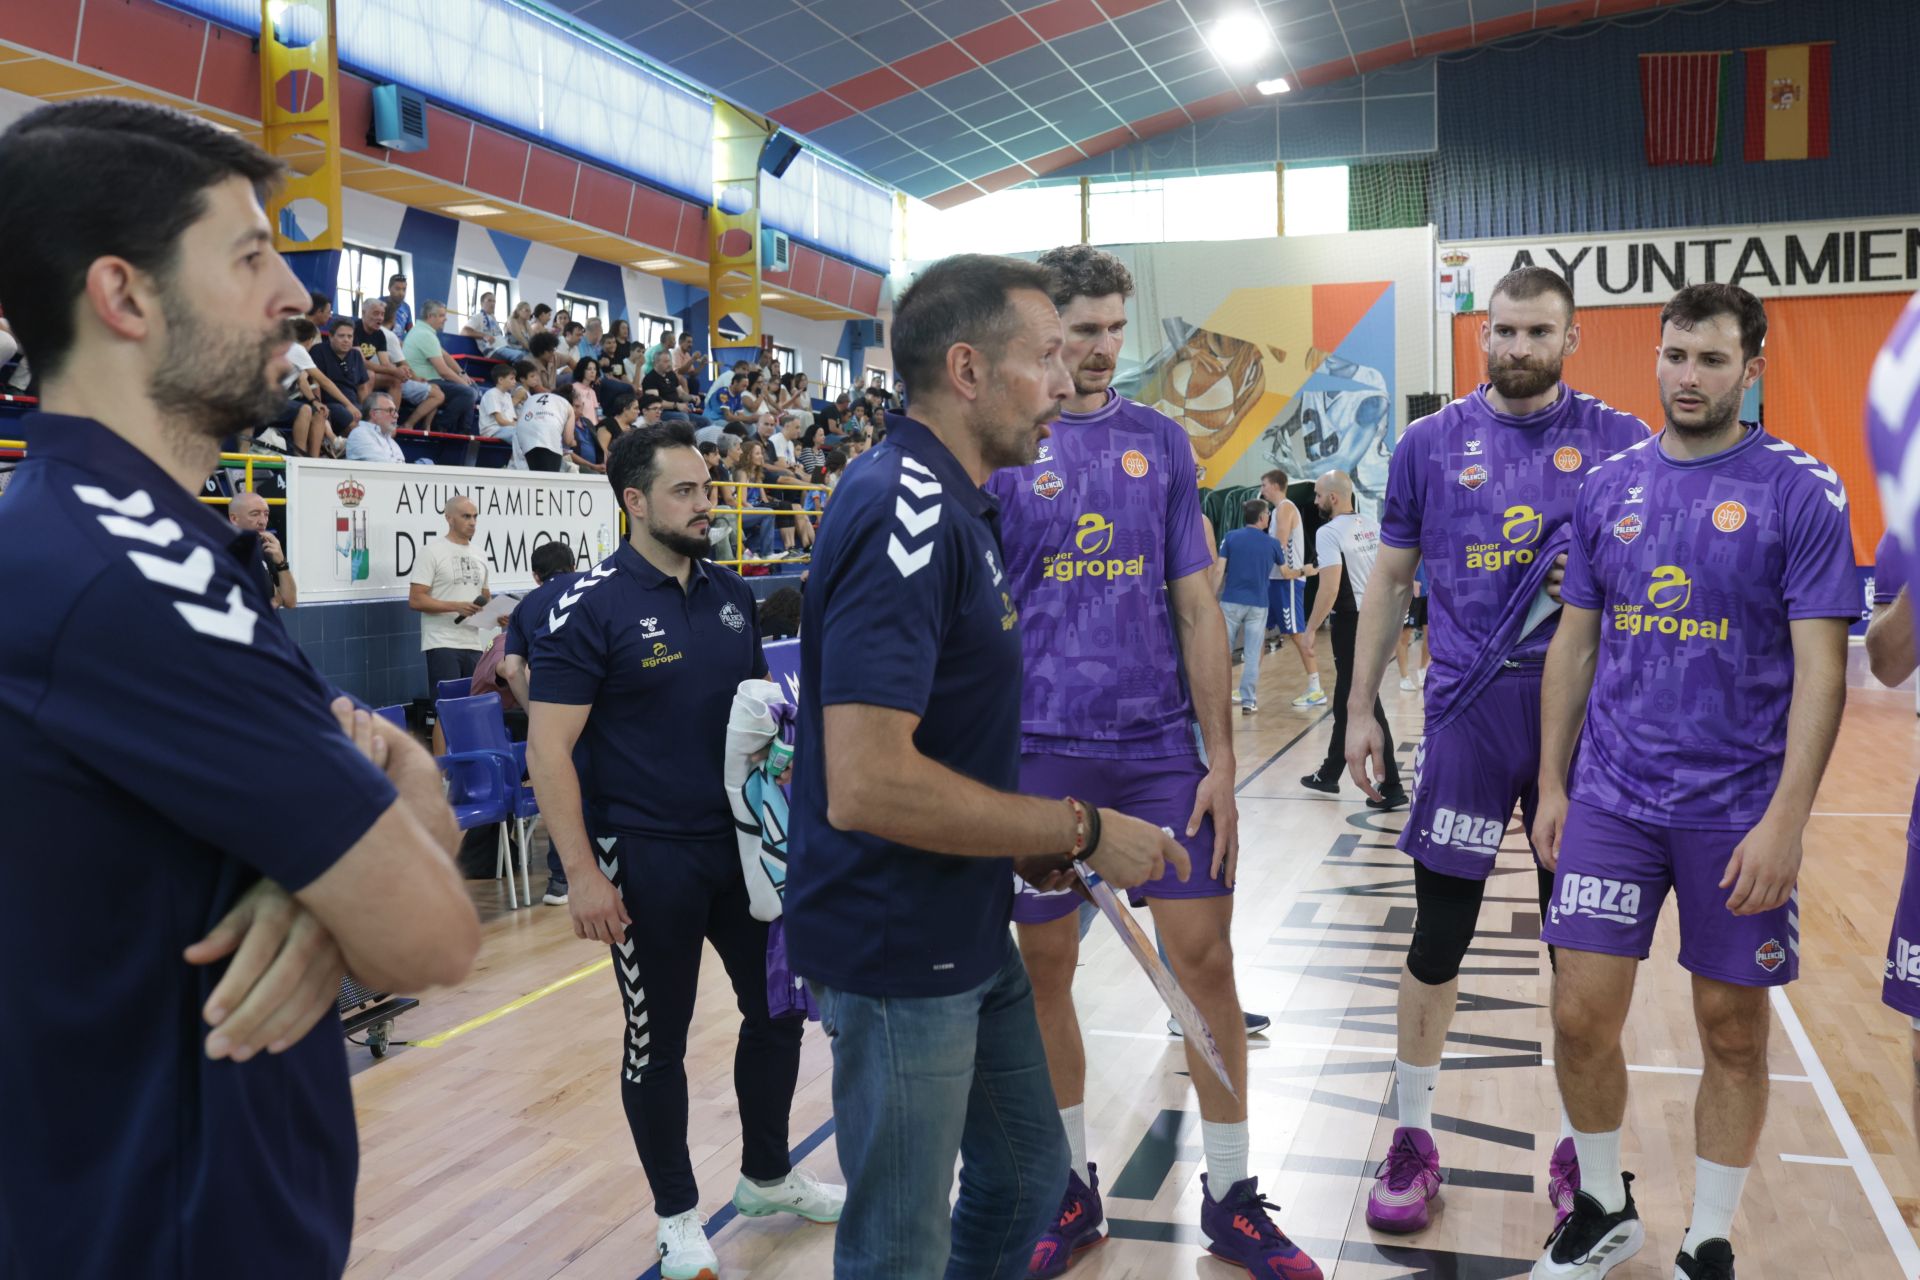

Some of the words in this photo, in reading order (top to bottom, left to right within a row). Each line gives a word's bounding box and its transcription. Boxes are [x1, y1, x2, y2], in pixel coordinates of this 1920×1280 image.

[536, 394, 549, 406] 4
[205, 477, 216, 492] 6
[469, 530, 592, 573] AMA
[1465, 542, 1501, 553] súper
[1466, 548, 1537, 572] agro
[1043, 554, 1145, 582] agropal
[1614, 612, 1729, 641] agropal
[642, 651, 683, 668] agropal
[1430, 807, 1504, 847] gaza
[1559, 873, 1641, 916] gaza
